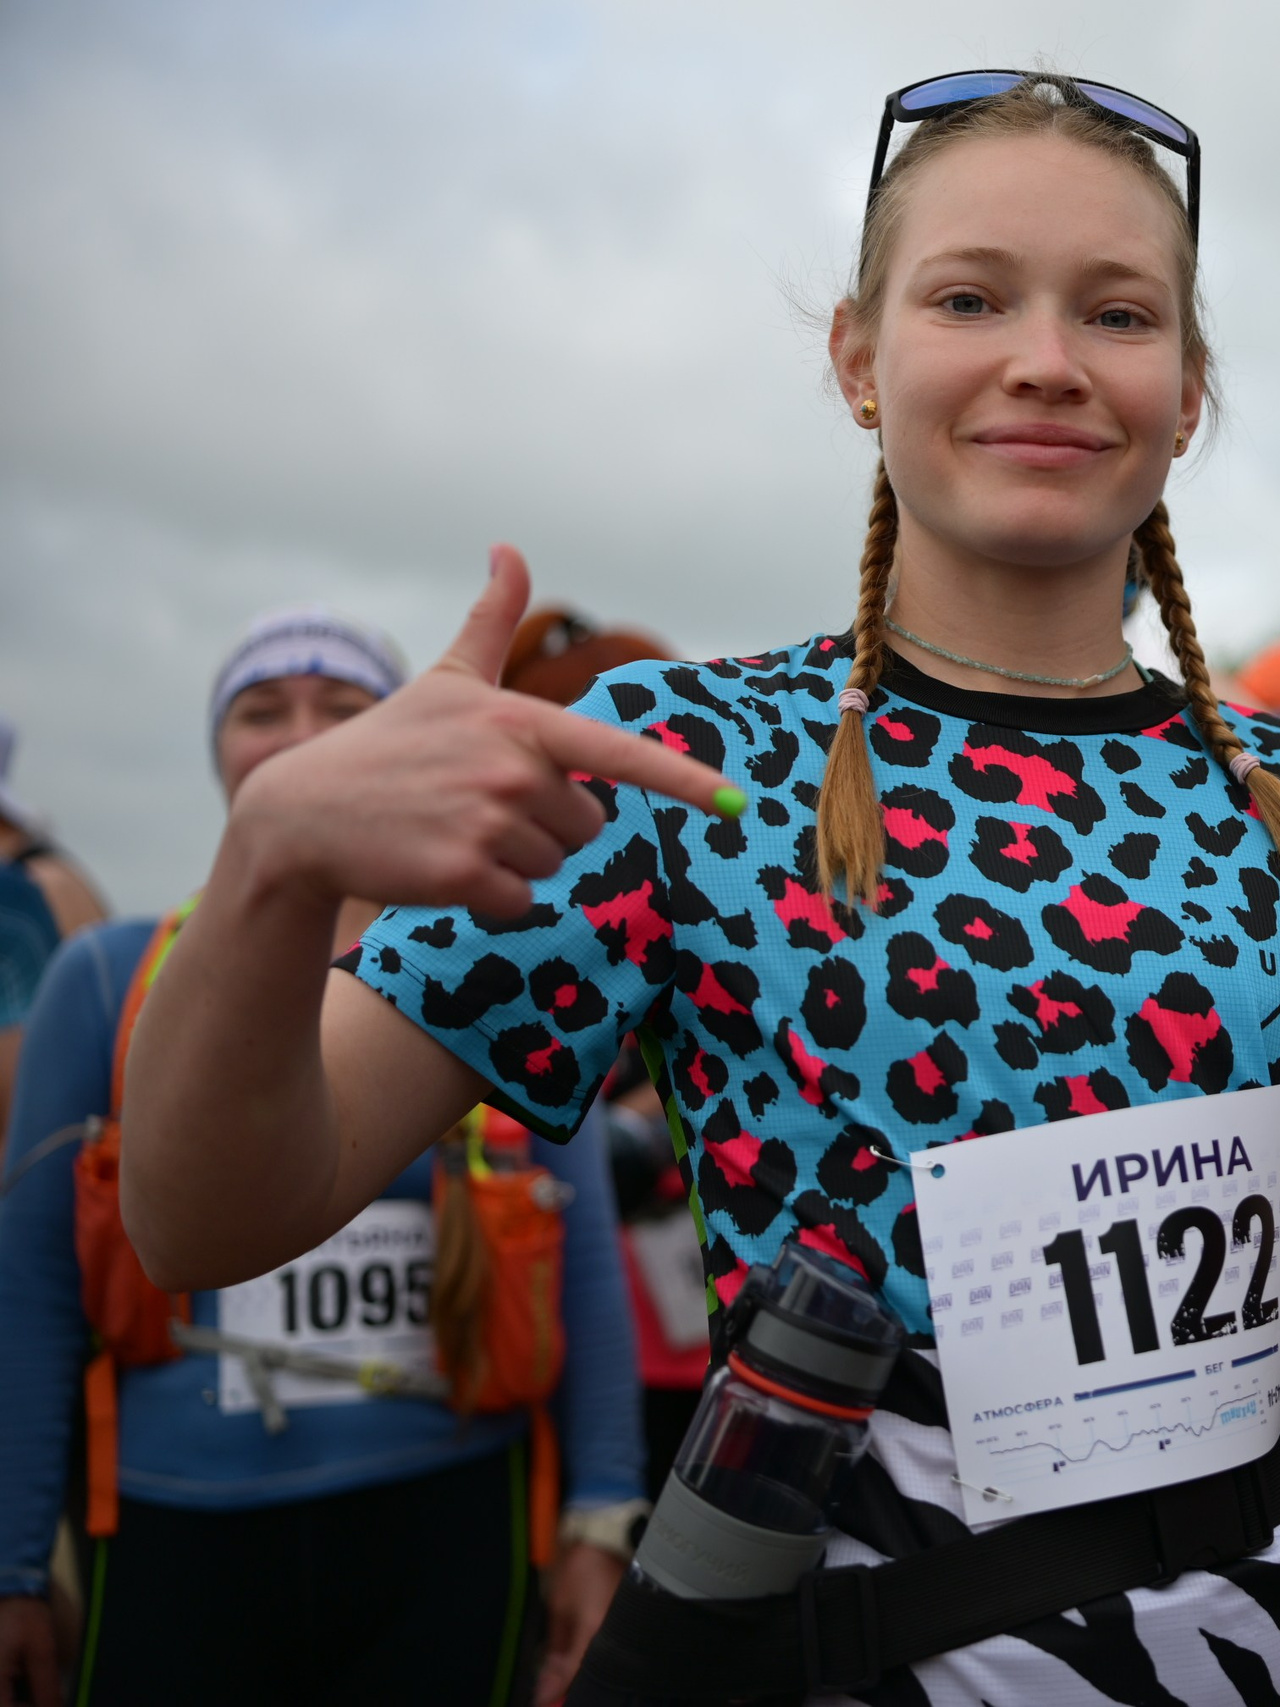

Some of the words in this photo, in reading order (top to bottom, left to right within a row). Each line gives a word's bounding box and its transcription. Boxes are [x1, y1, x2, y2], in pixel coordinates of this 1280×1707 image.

[1071, 1136, 1252, 1202] ИРИНА
[1009, 1277, 1032, 1296] DAN
[1043, 1193, 1279, 1366] 1122
[279, 1261, 433, 1335] 1095
[969, 1285, 992, 1304] DAN
[1205, 1362, 1224, 1375] БЕГ
[973, 1396, 1064, 1423] АТМОСФЕРА
